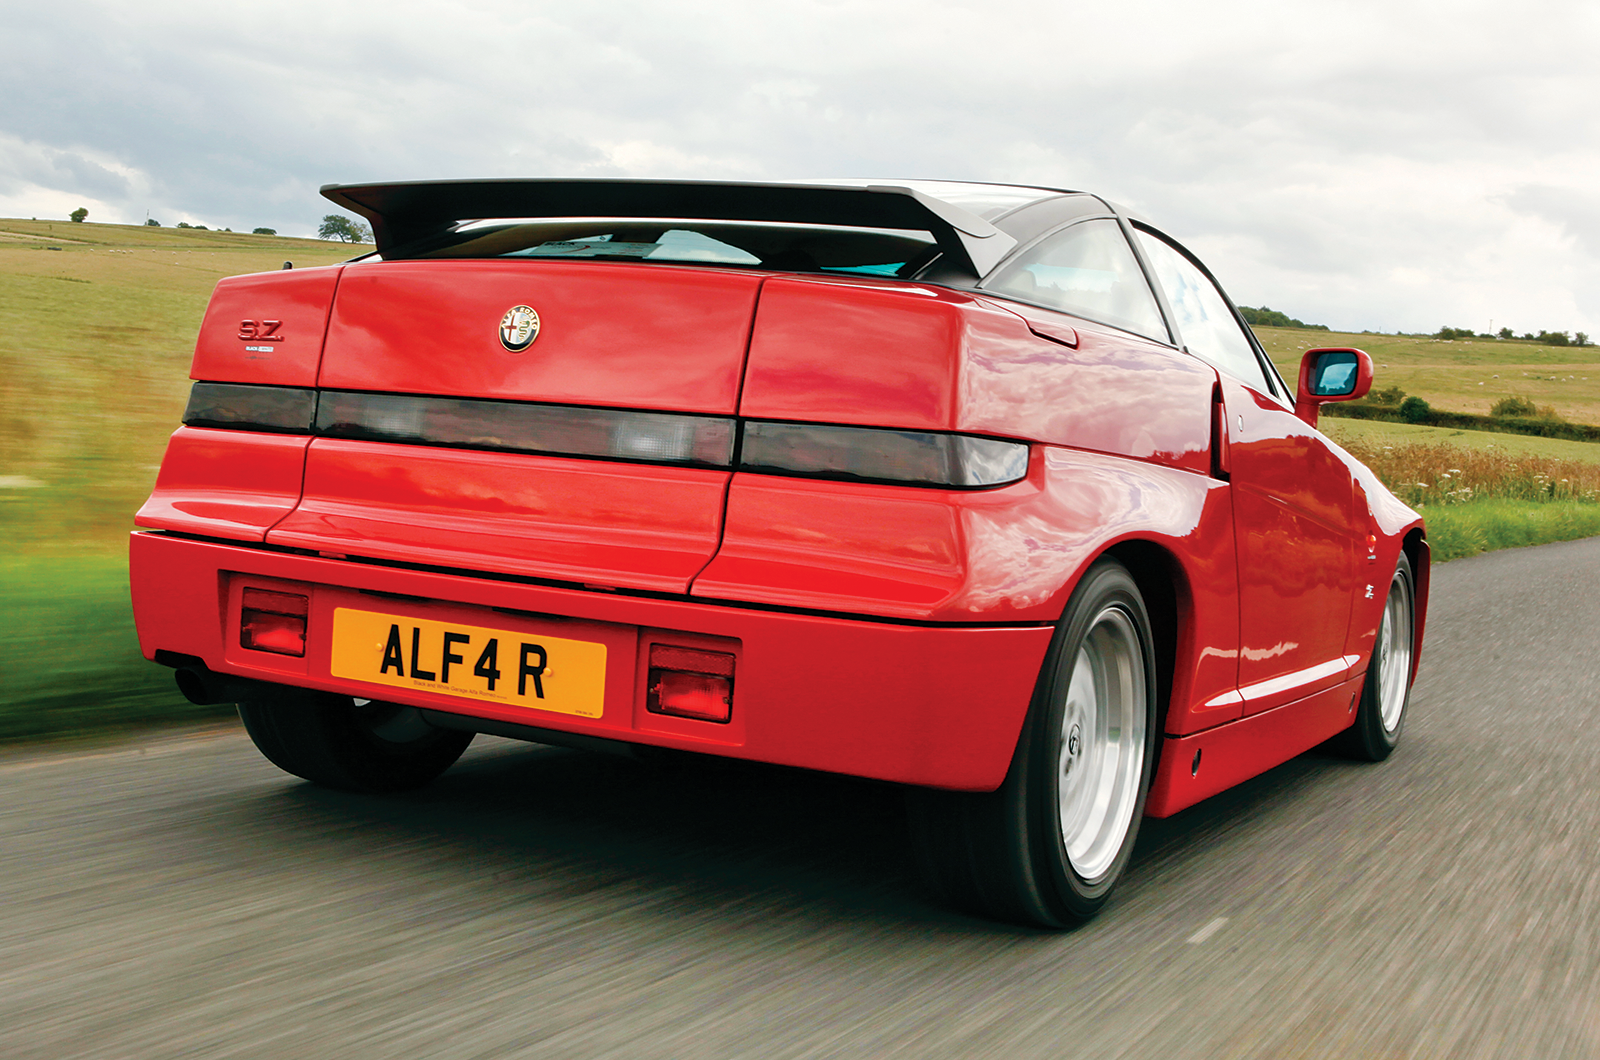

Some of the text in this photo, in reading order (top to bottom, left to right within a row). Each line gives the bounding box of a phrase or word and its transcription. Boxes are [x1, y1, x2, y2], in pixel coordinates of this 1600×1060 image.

[520, 307, 538, 330] ROMEO
[380, 624, 547, 699] ALF4 R
[450, 686, 468, 694] Garage
[479, 690, 496, 698] Romeo
